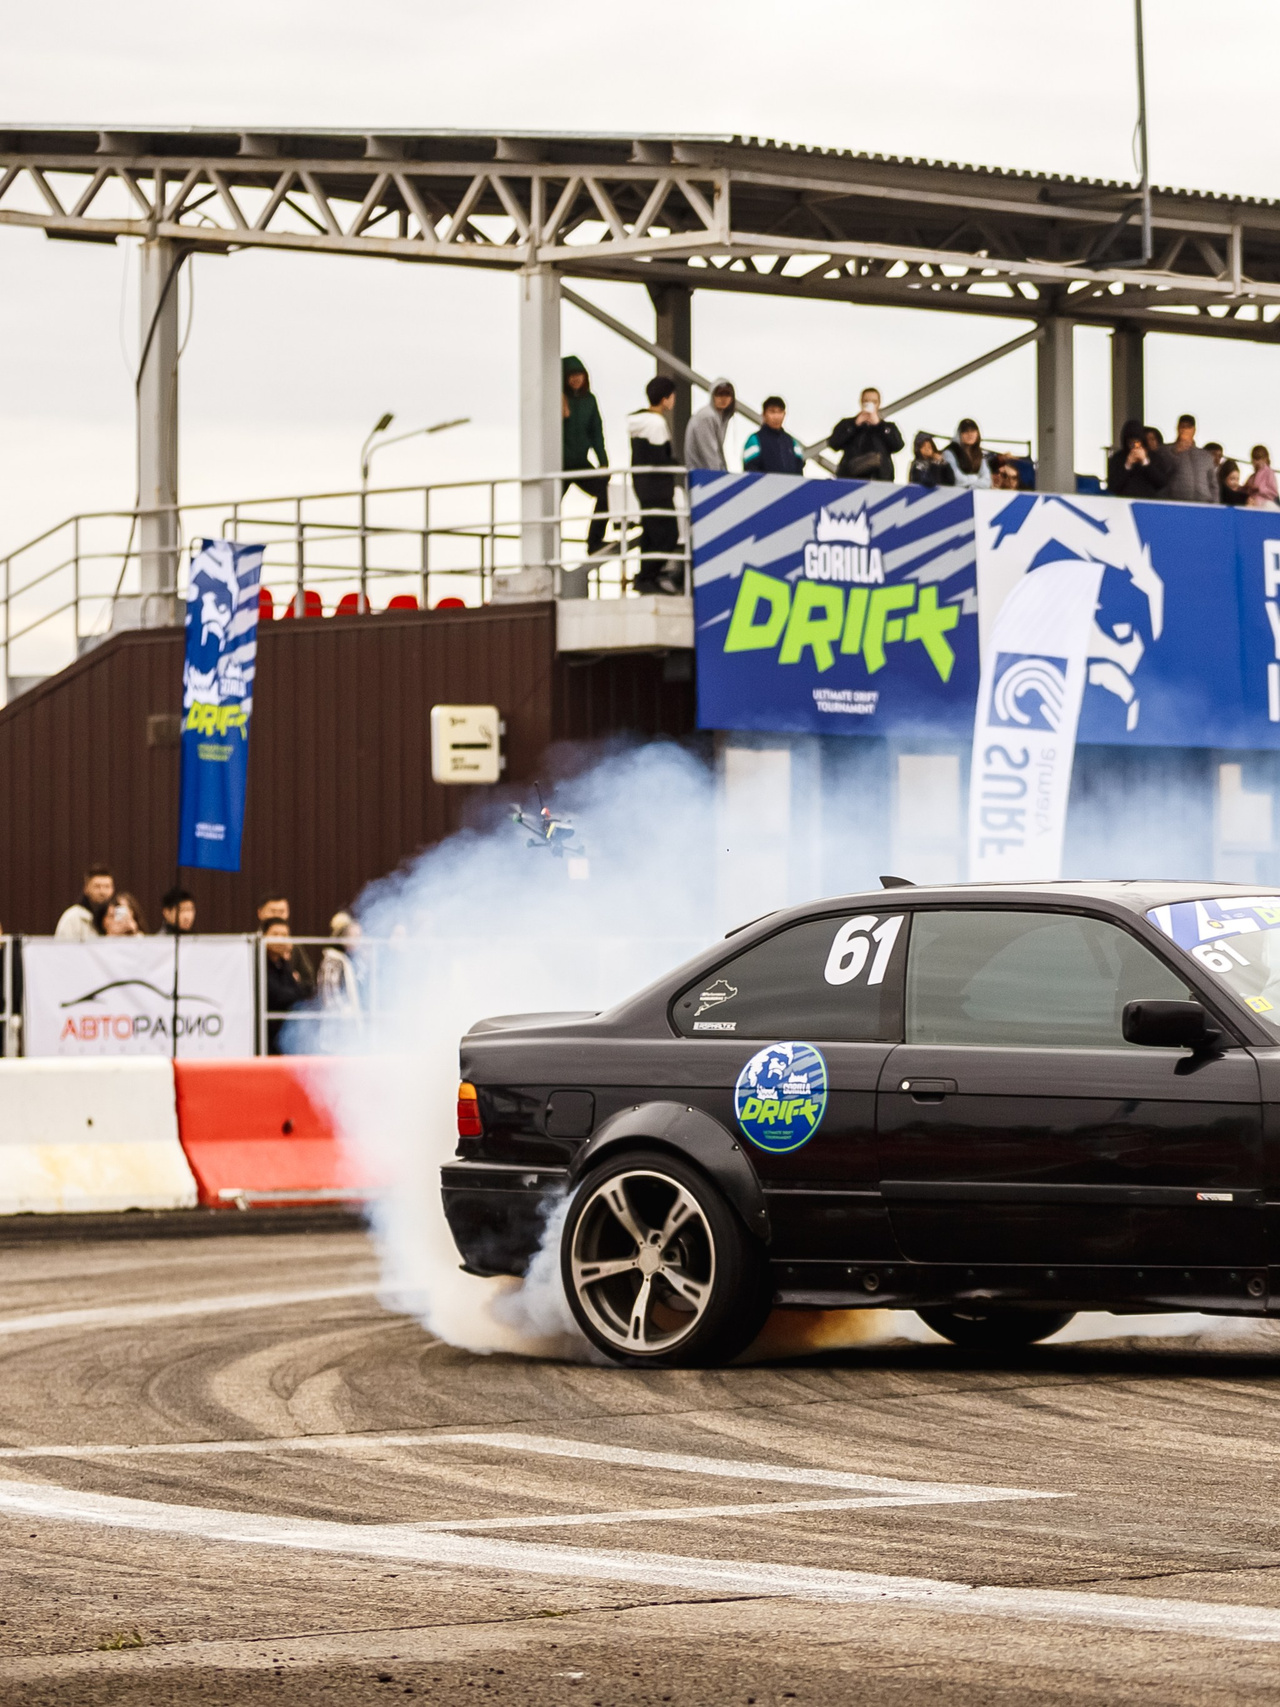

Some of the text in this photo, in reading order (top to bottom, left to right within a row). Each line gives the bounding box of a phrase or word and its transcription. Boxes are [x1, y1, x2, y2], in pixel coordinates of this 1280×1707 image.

[804, 543, 884, 584] GORILLA
[723, 569, 960, 683] DRIFT
[812, 688, 879, 702] ULTIMATE DRIFT
[817, 702, 876, 714] TOURNAMENT
[823, 915, 904, 986] 61
[1192, 939, 1251, 973] 61
[740, 1096, 819, 1127] DRIFT
